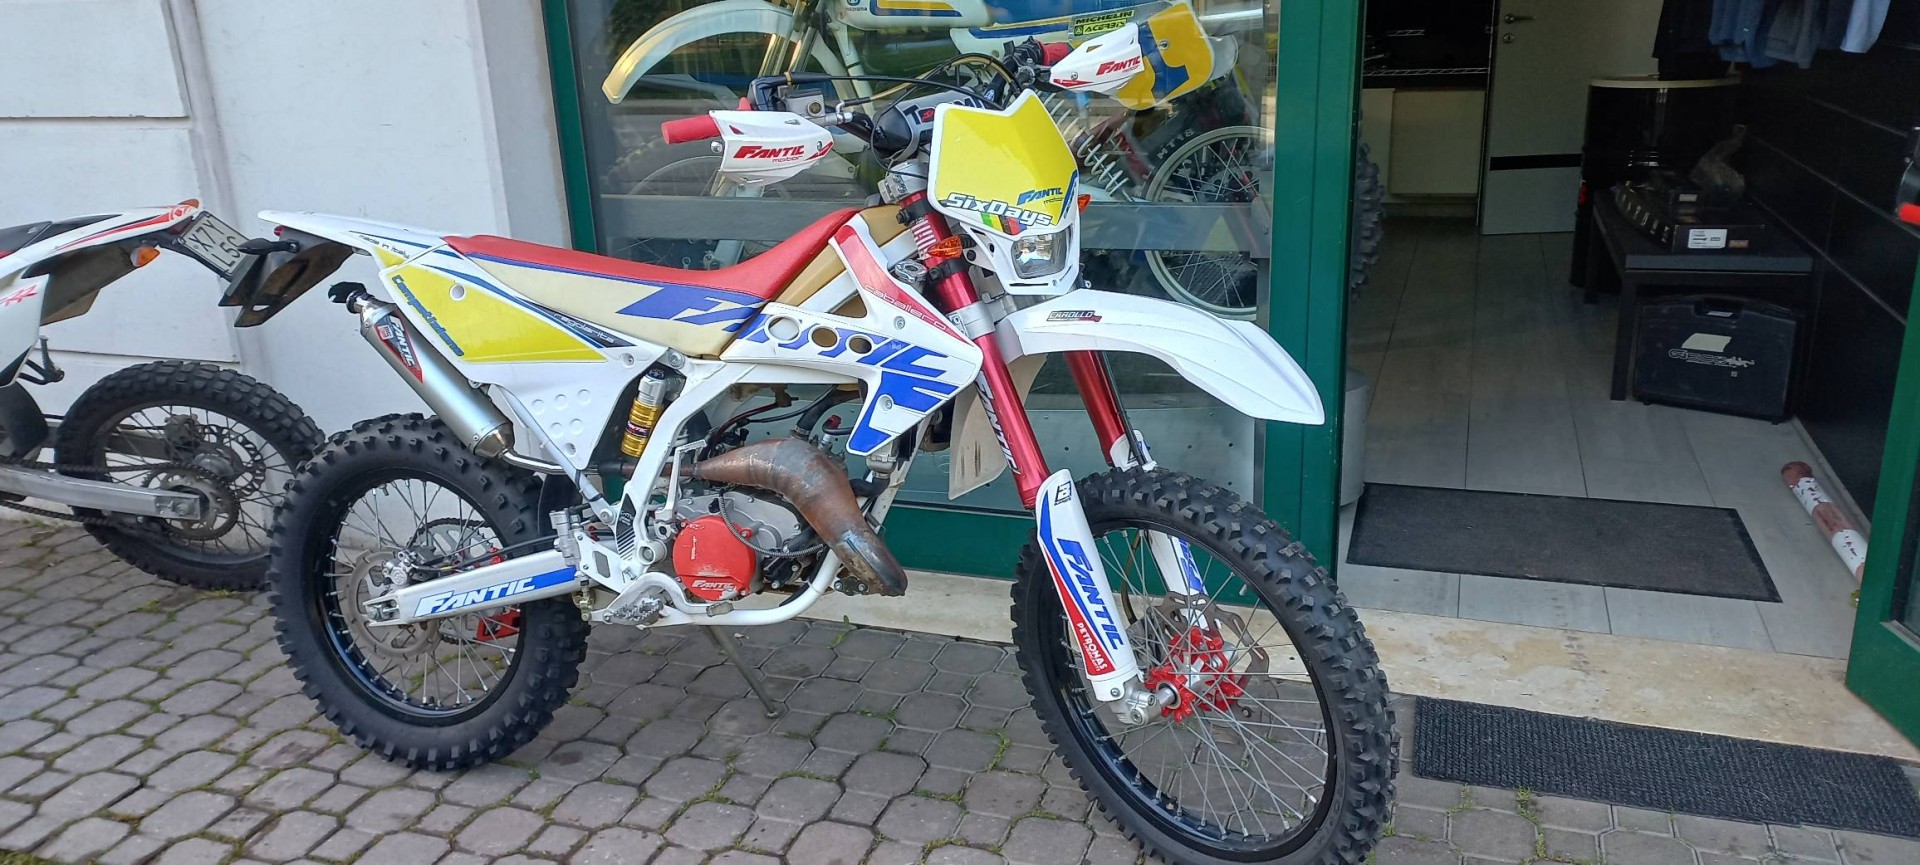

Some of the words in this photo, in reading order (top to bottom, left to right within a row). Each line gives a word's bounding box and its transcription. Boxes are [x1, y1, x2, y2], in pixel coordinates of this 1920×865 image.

[1075, 10, 1133, 24] MICHELIN
[1096, 56, 1141, 76] FANTIC
[733, 145, 804, 159] FANTIC
[946, 192, 1053, 226] SixDays
[1017, 187, 1063, 206] FANTIC
[188, 219, 225, 252] X7Y
[389, 318, 416, 368] FANTIC
[975, 368, 1021, 475] FANTIC
[414, 577, 536, 617] FANTIC
[691, 579, 735, 590] FANTIC
[1057, 538, 1124, 650] FANTIC
[1077, 622, 1108, 670] PETRONAS
